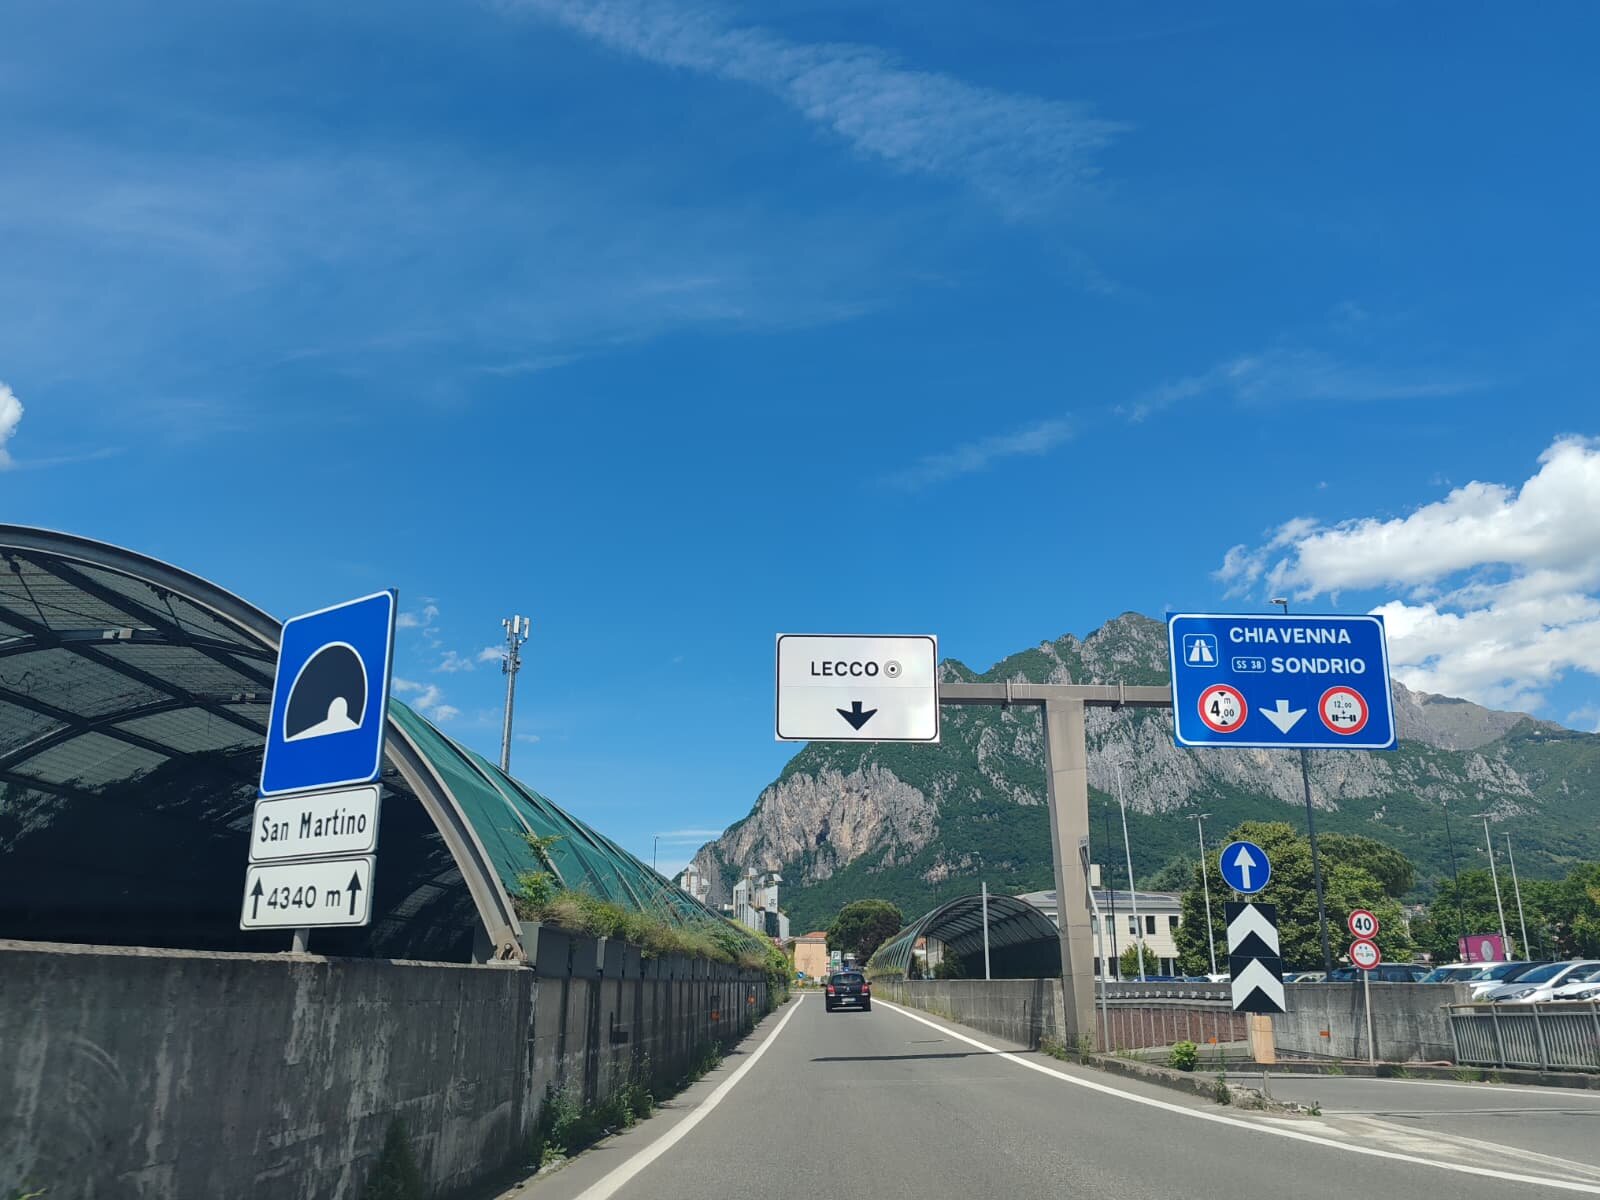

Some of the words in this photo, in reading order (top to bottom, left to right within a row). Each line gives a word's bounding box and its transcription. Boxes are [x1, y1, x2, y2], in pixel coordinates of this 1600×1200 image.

[1229, 627, 1351, 644] CHIAVENNA
[811, 661, 879, 676] LECCO
[1236, 661, 1247, 669] SS
[1271, 658, 1366, 674] SONDRIO
[261, 816, 289, 842] San
[299, 808, 366, 839] Martino
[267, 885, 316, 909] 4340
[325, 889, 341, 907] m
[1355, 918, 1371, 931] 40
